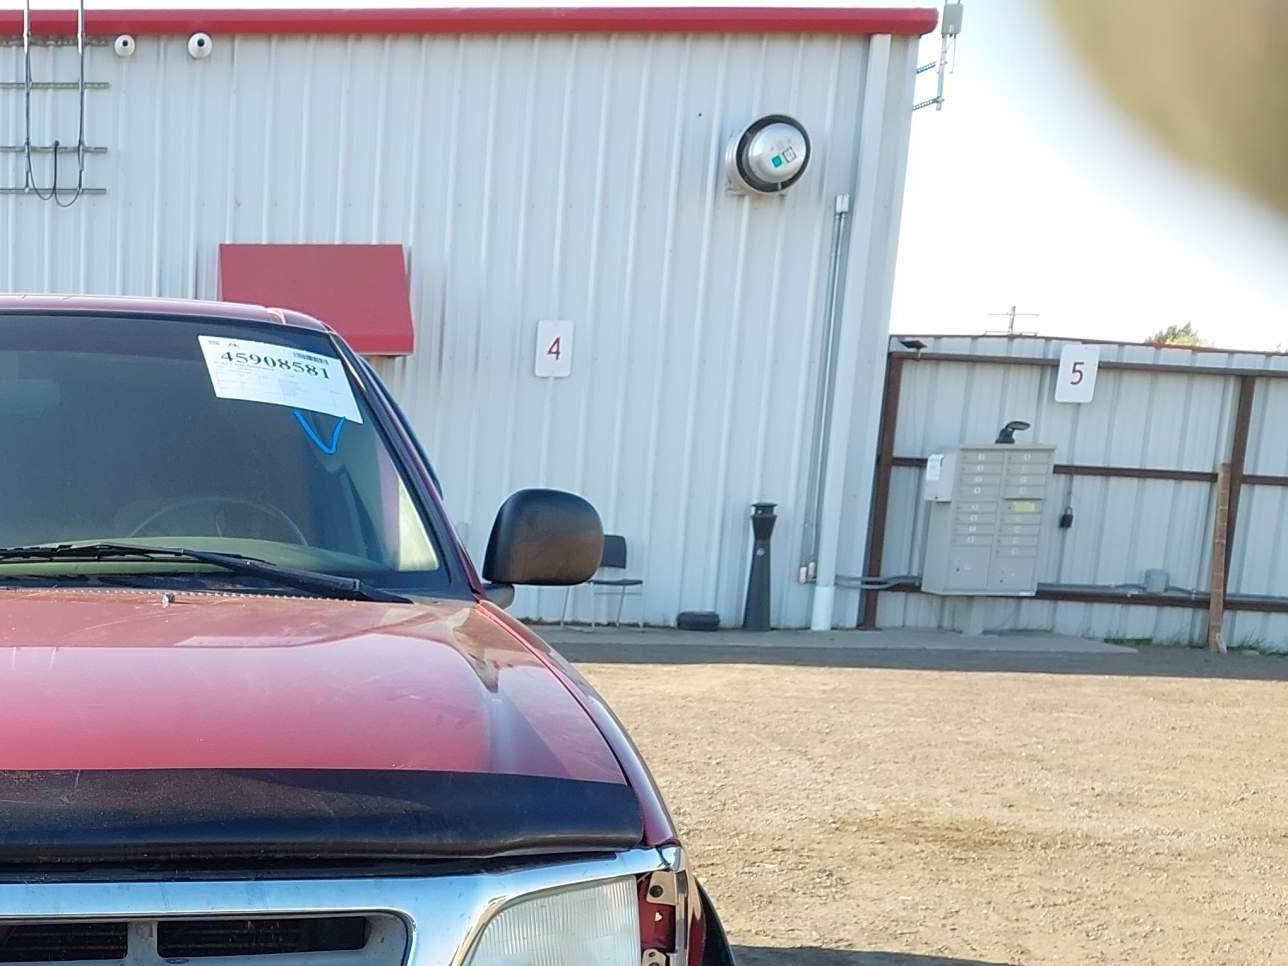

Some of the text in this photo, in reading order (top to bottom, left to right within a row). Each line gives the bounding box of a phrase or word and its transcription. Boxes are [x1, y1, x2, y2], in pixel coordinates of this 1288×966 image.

[547, 336, 561, 361] 4
[220, 350, 330, 380] 45908581
[1070, 361, 1085, 386] 5
